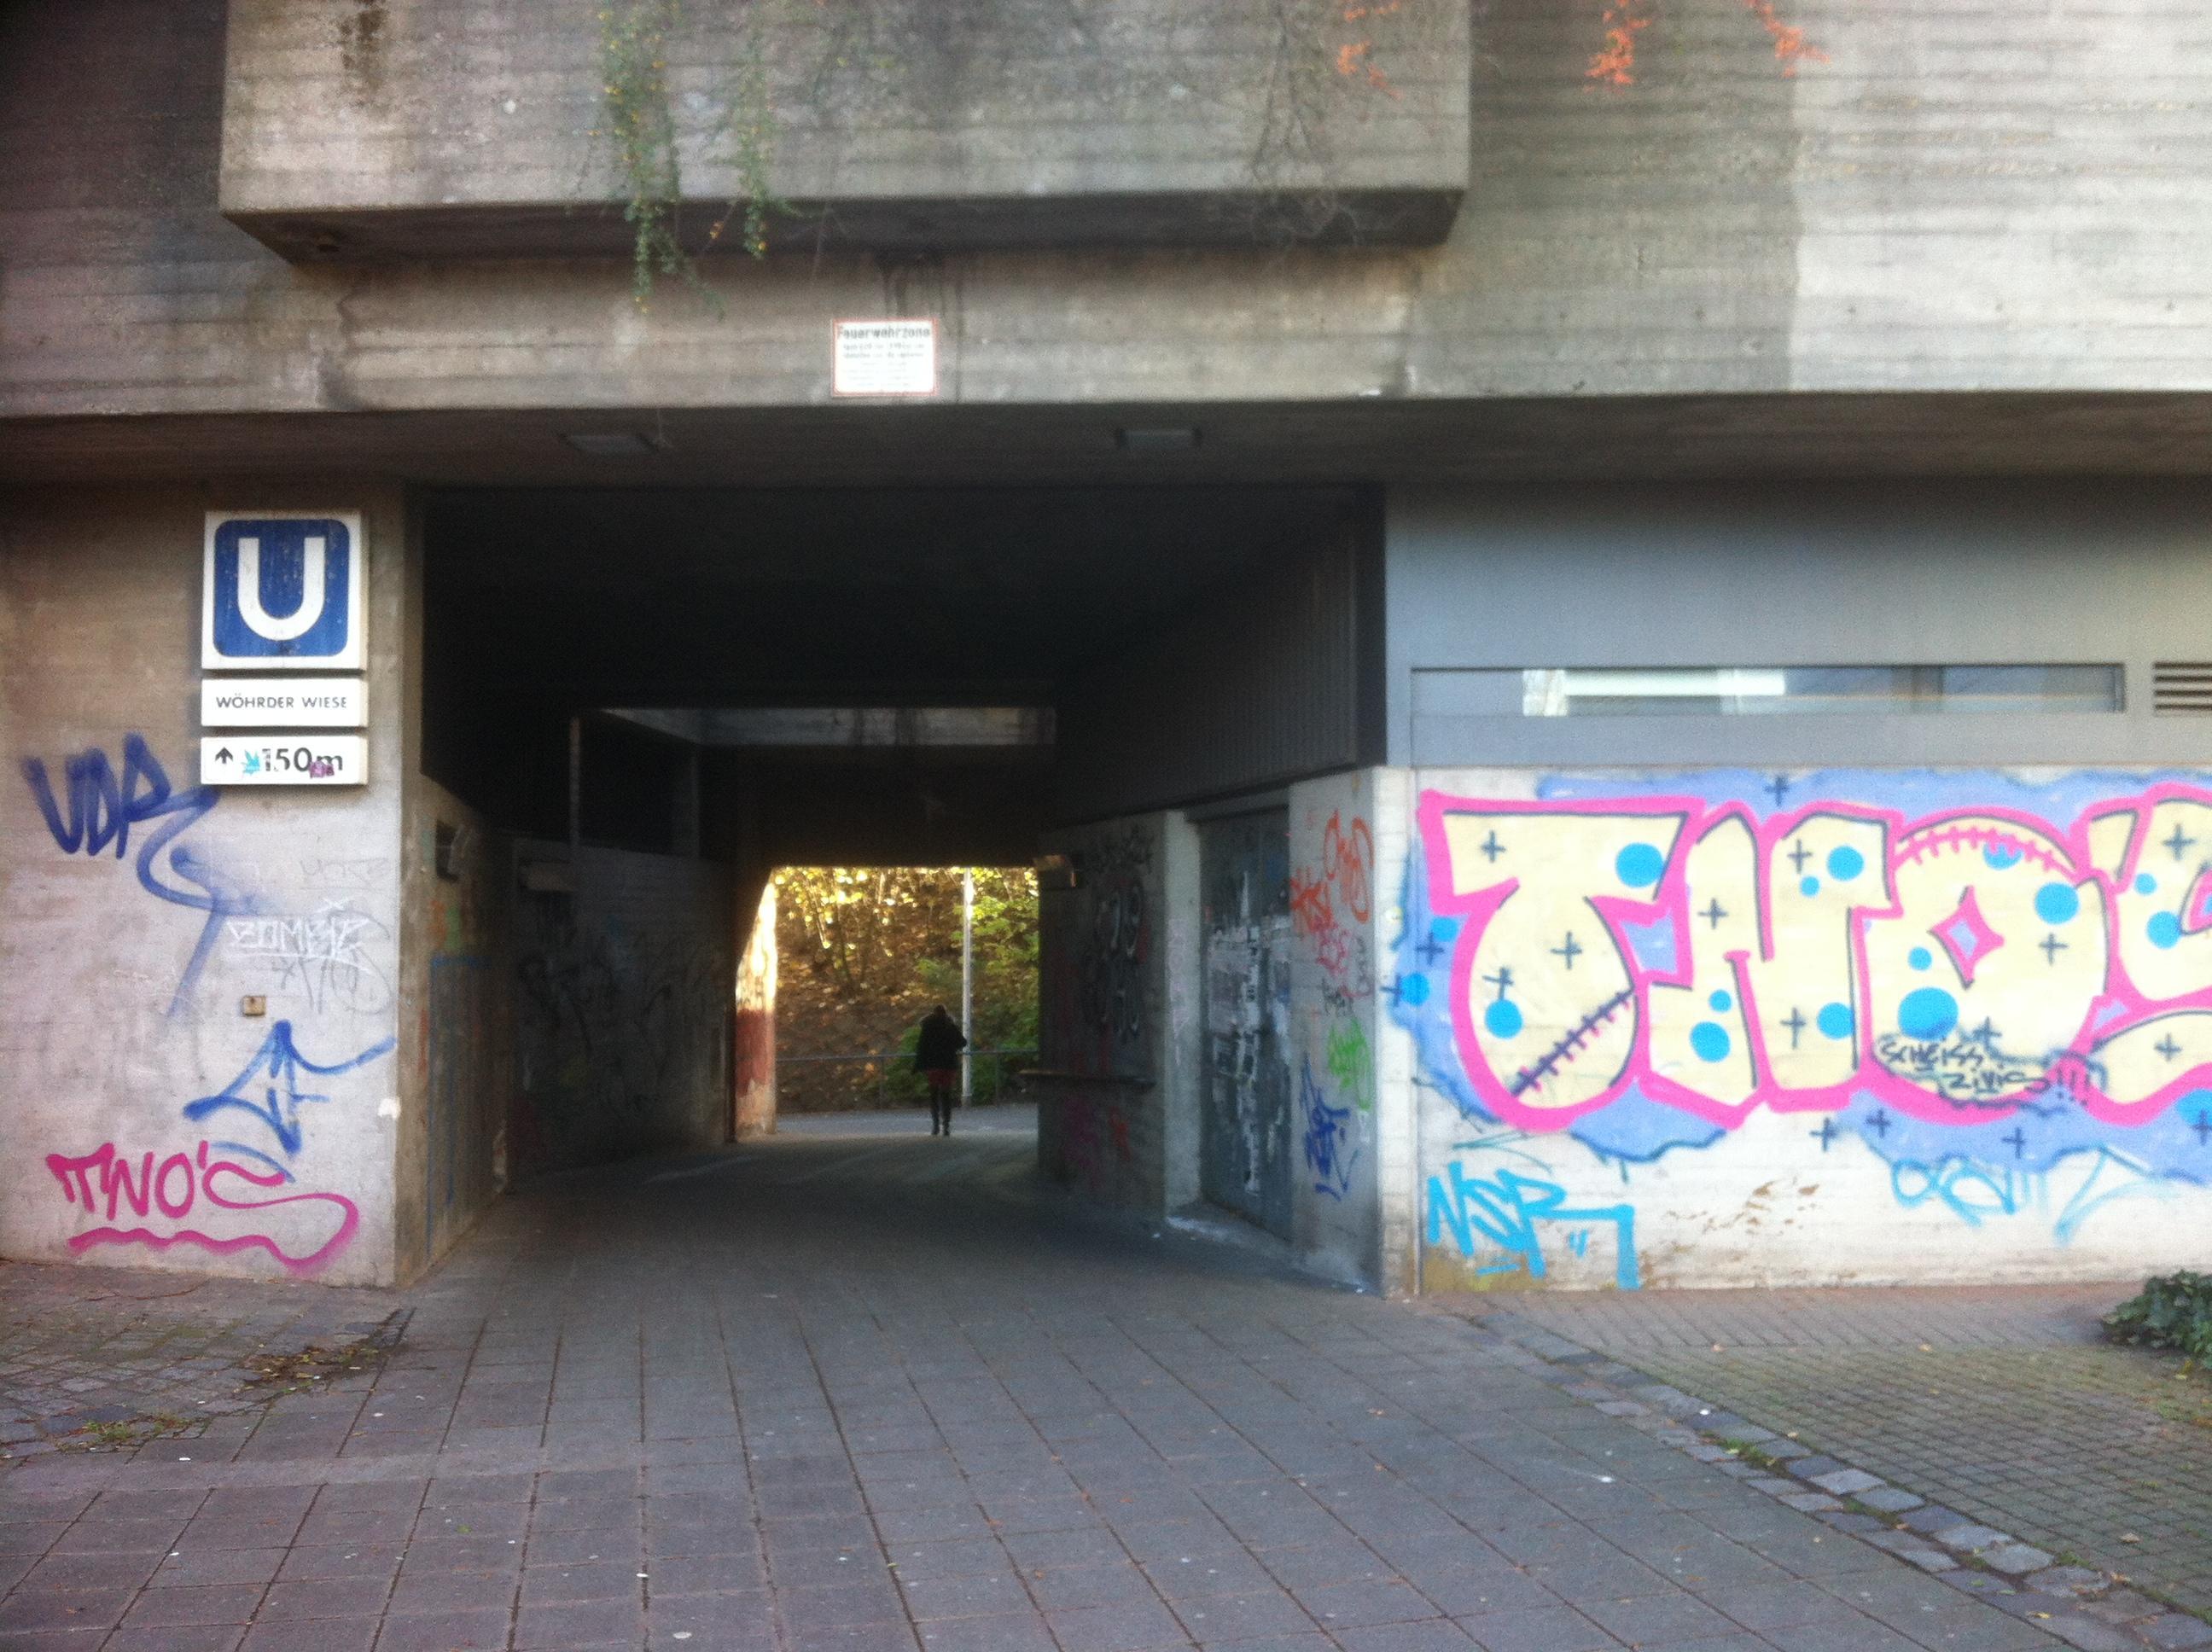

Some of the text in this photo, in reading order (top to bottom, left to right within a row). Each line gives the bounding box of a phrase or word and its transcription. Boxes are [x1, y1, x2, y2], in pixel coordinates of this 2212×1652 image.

[237, 537, 326, 641] U
[215, 693, 347, 709] WÖHRDER WIESE
